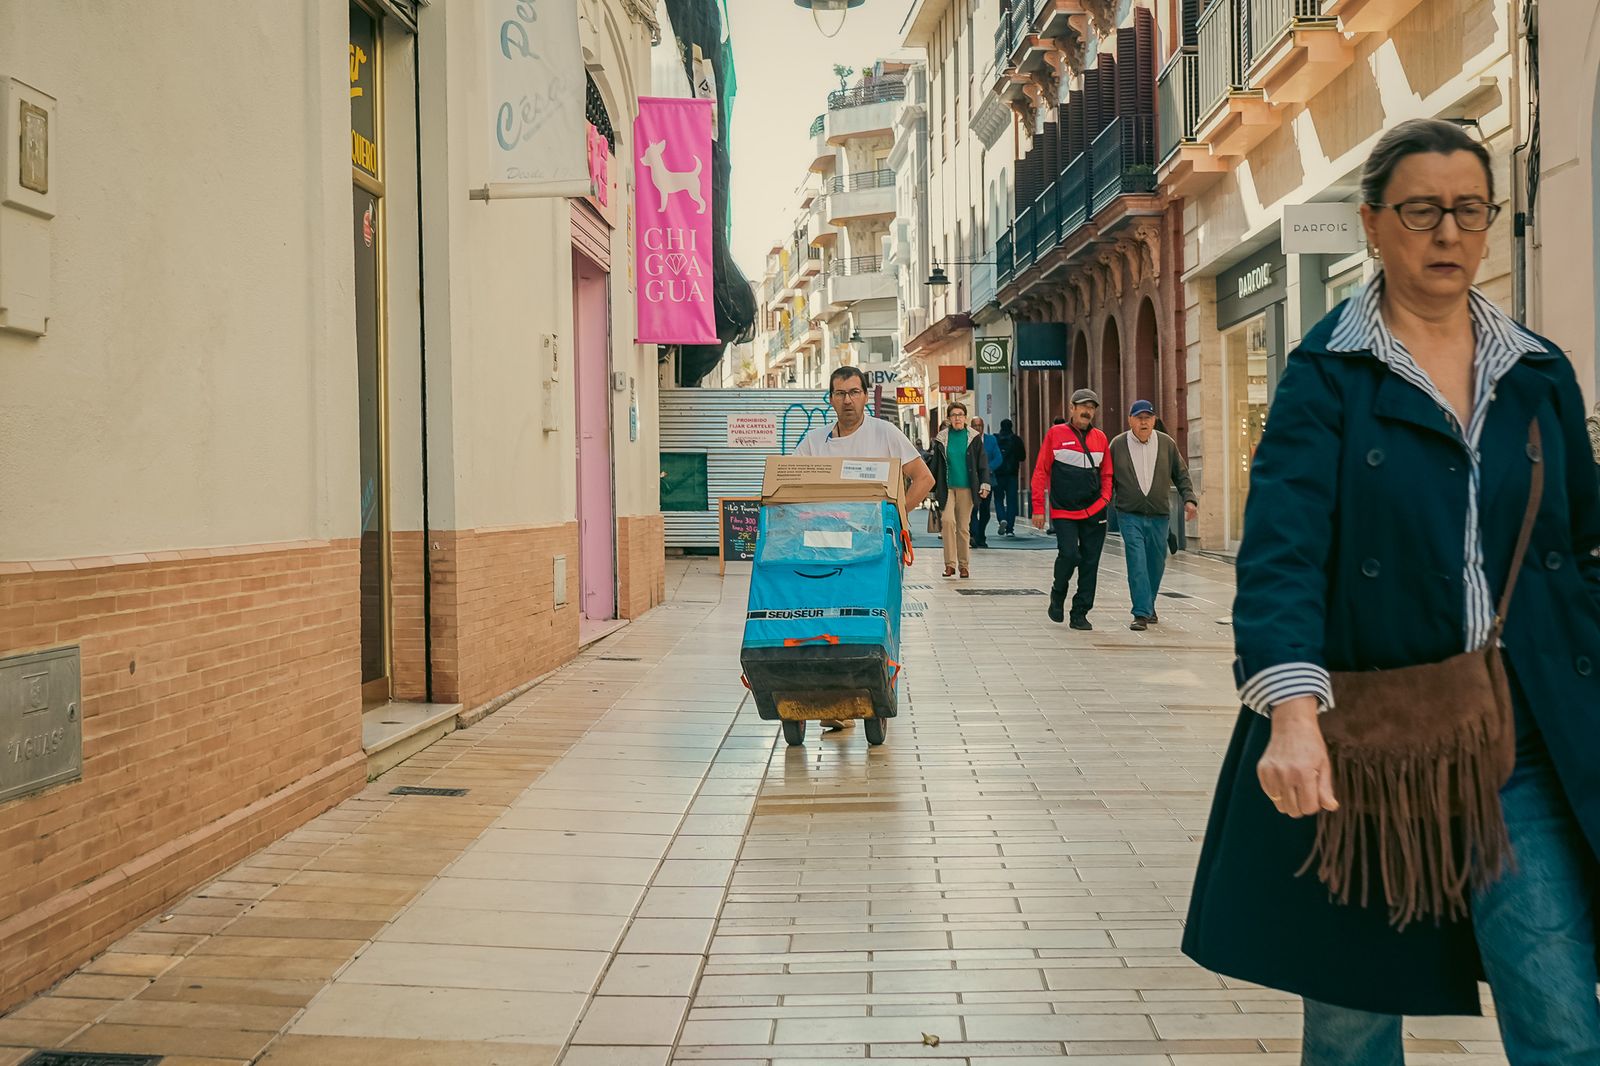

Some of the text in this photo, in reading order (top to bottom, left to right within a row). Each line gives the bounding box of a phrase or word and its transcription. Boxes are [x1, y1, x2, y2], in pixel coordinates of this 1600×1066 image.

[644, 227, 697, 251] CHI
[1293, 223, 1348, 232] PARFOIS
[645, 279, 705, 303] GUA
[1238, 262, 1272, 299] PARFOIS
[768, 610, 793, 619] SEU
[792, 609, 824, 618] SEUR
